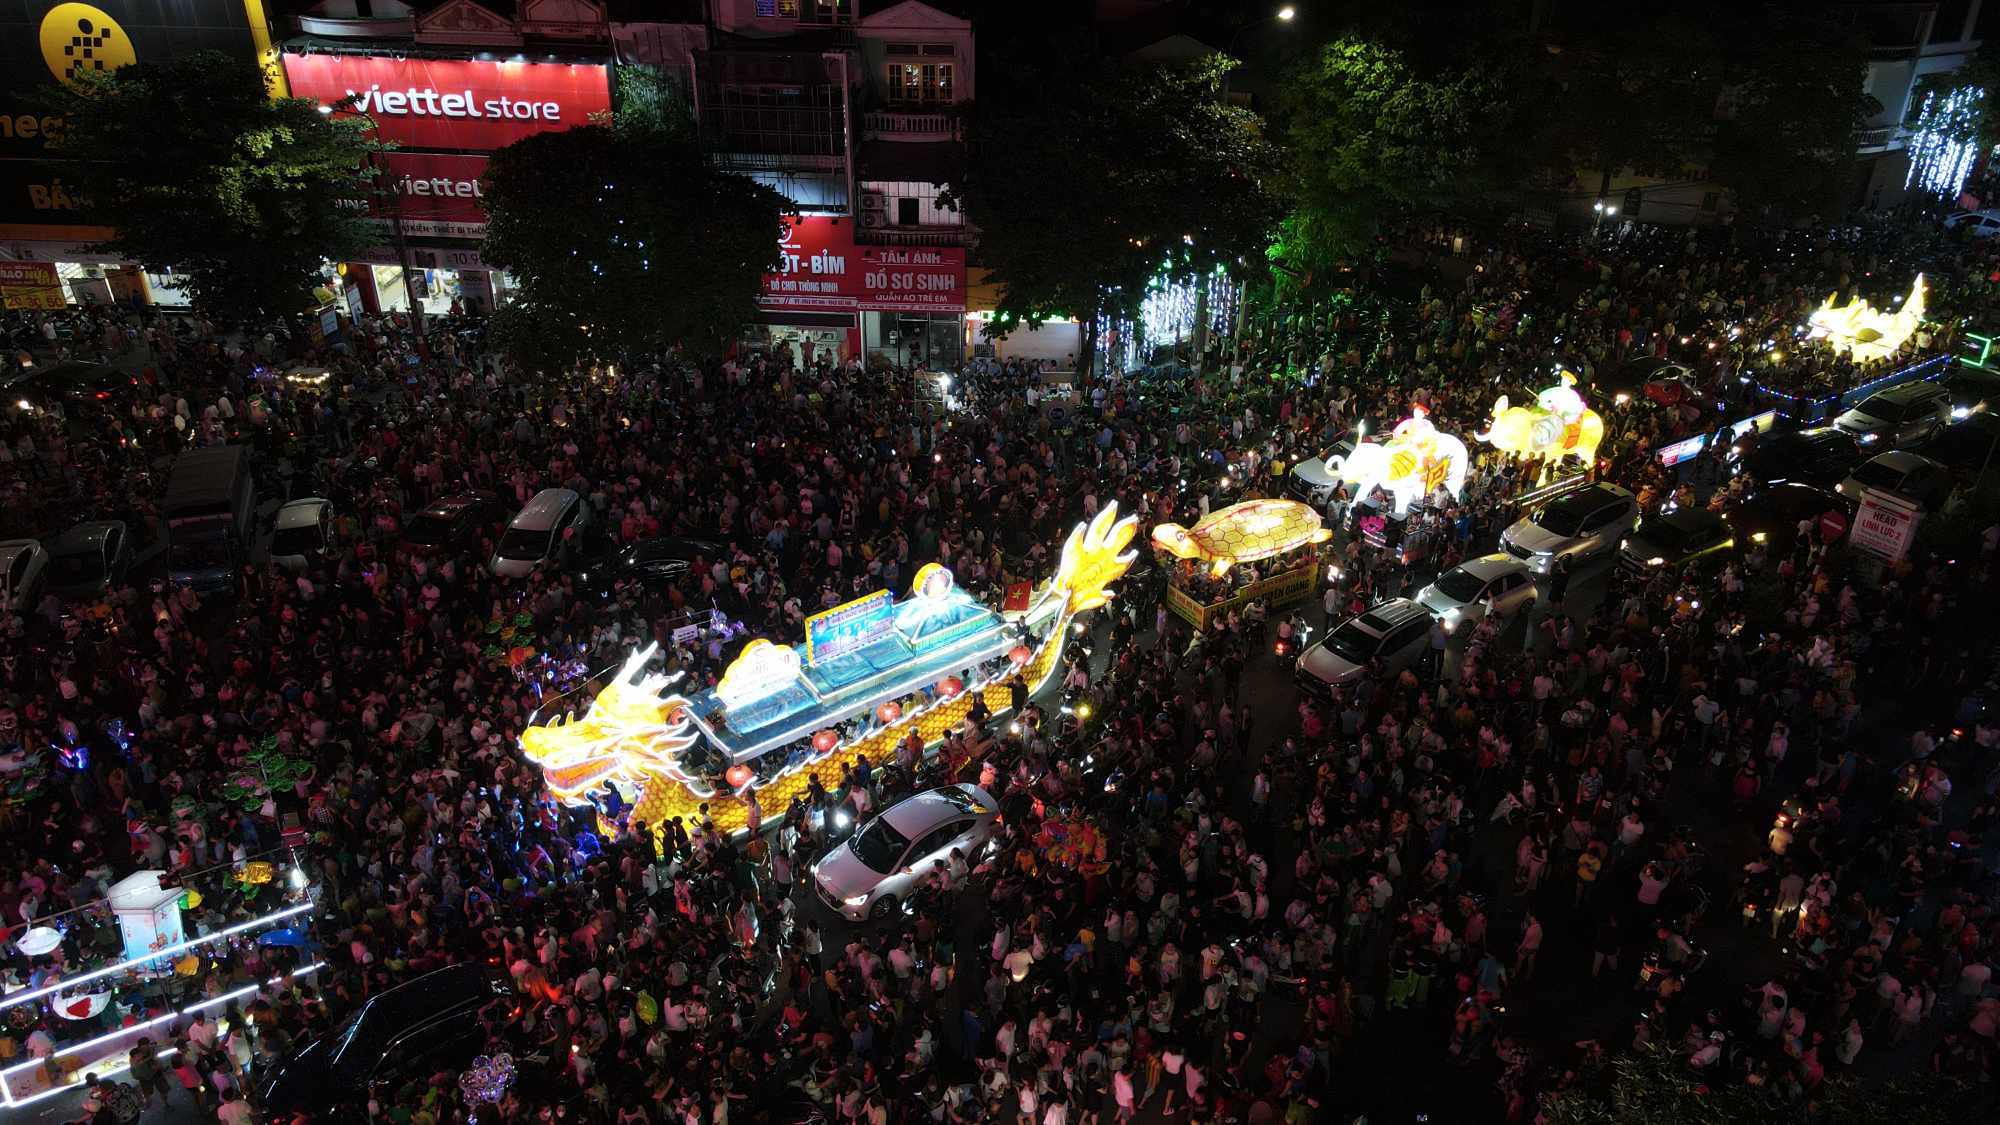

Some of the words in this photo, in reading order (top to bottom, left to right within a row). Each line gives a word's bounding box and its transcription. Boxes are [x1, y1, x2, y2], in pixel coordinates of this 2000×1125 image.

[345, 84, 482, 118] viettel
[484, 96, 561, 121] store
[811, 249, 845, 274] BỈM
[865, 267, 888, 290] ĐỒ
[891, 272, 914, 291] SƠ
[916, 273, 955, 291] SINH
